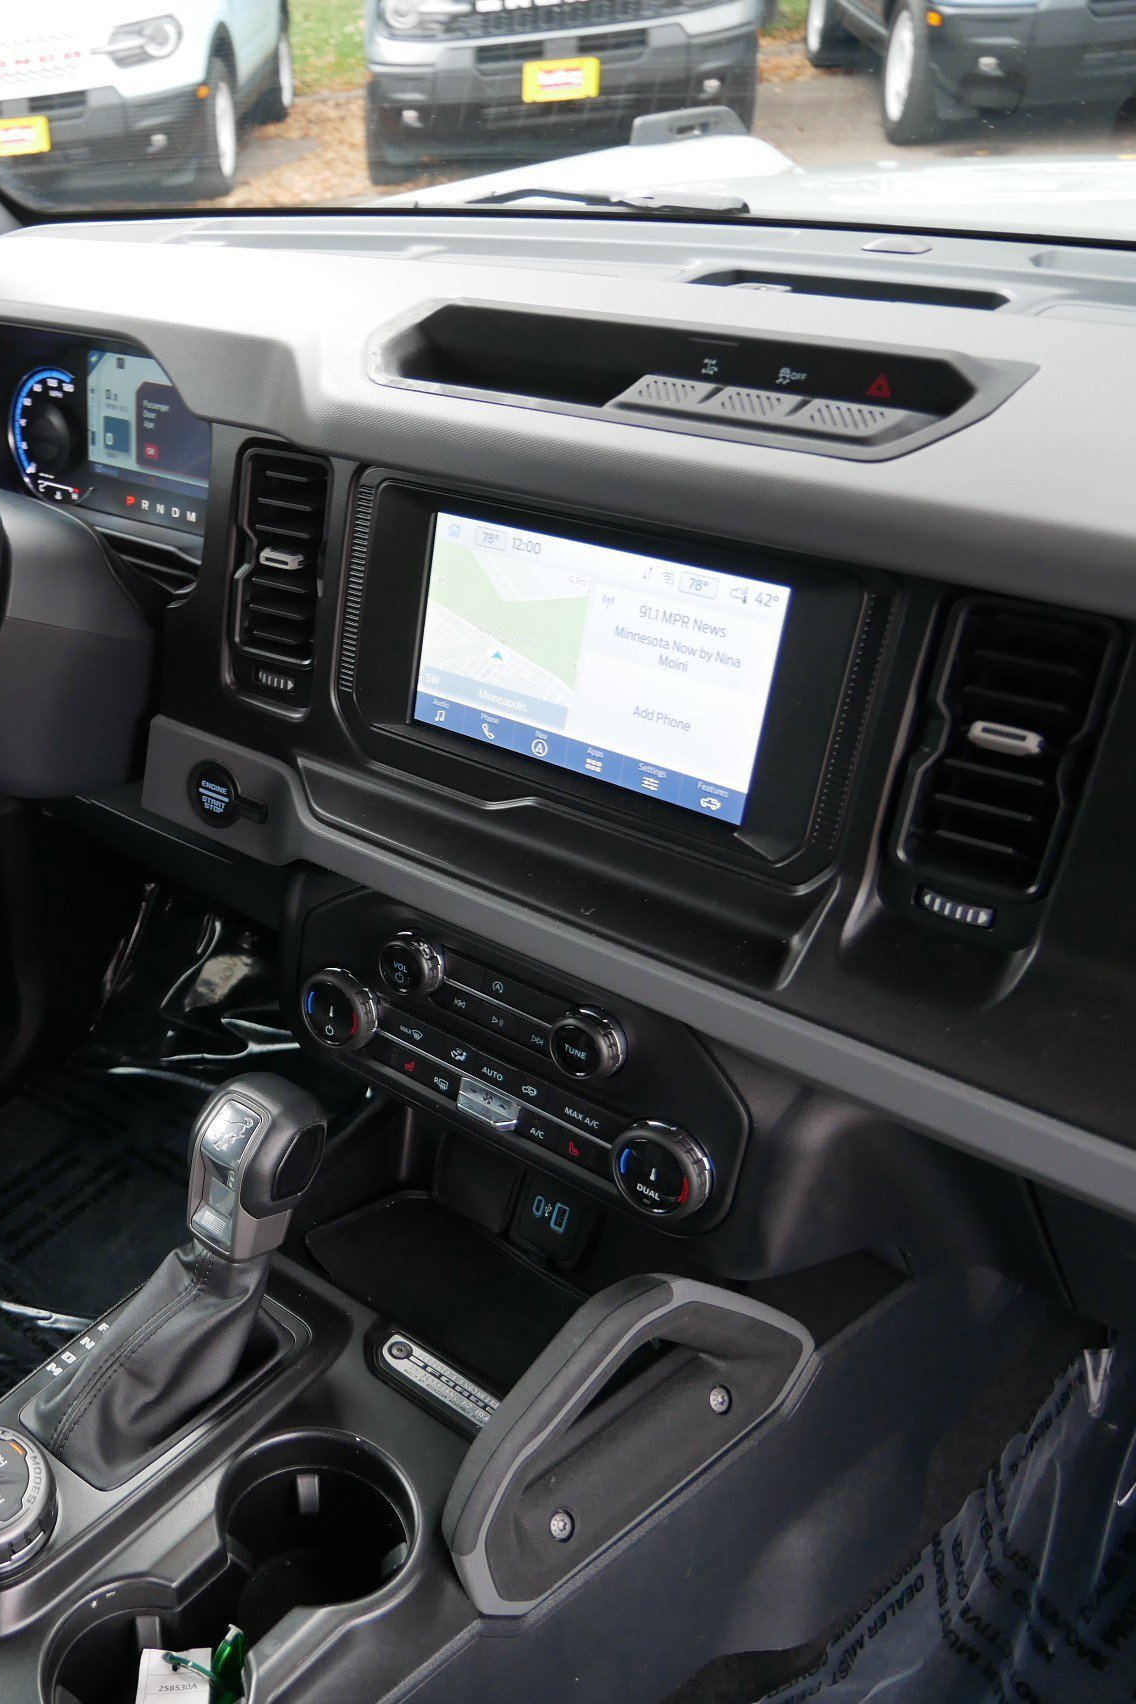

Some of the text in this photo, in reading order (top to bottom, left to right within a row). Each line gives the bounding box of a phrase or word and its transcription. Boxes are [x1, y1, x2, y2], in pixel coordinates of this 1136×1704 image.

[126, 496, 196, 522] P R N D M
[482, 531, 542, 555] 78° 12:00
[688, 577, 780, 608] 78° 42°
[639, 605, 727, 638] 91.1 MPR News
[614, 625, 742, 668] Minnesota Now by Nina
[657, 654, 689, 672] Moini
[432, 699, 450, 709] Audio
[478, 689, 529, 712] Minneapolis
[480, 713, 499, 725] Phone
[632, 706, 691, 732] Add Phone
[535, 730, 548, 740] Nav
[586, 746, 605, 759] Apps
[638, 762, 667, 779] Settings
[201, 780, 228, 795] ENGINE
[696, 781, 729, 798] Features
[201, 795, 226, 809] START
[204, 802, 224, 814] STOP
[393, 961, 408, 973] VOL
[399, 1025, 413, 1036] MAX
[564, 1044, 587, 1060] TUNE
[482, 1066, 504, 1081] AUTO
[564, 1106, 600, 1130] MAX A/C
[529, 1127, 545, 1139] A/C
[636, 1183, 660, 1201] DUAL
[80, 1336, 96, 1350] N
[61, 1351, 77, 1364] D
[46, 1362, 64, 1377] M
[29, 1453, 43, 1505] MODES
[827, 1573, 925, 1687] DEALER MUST
